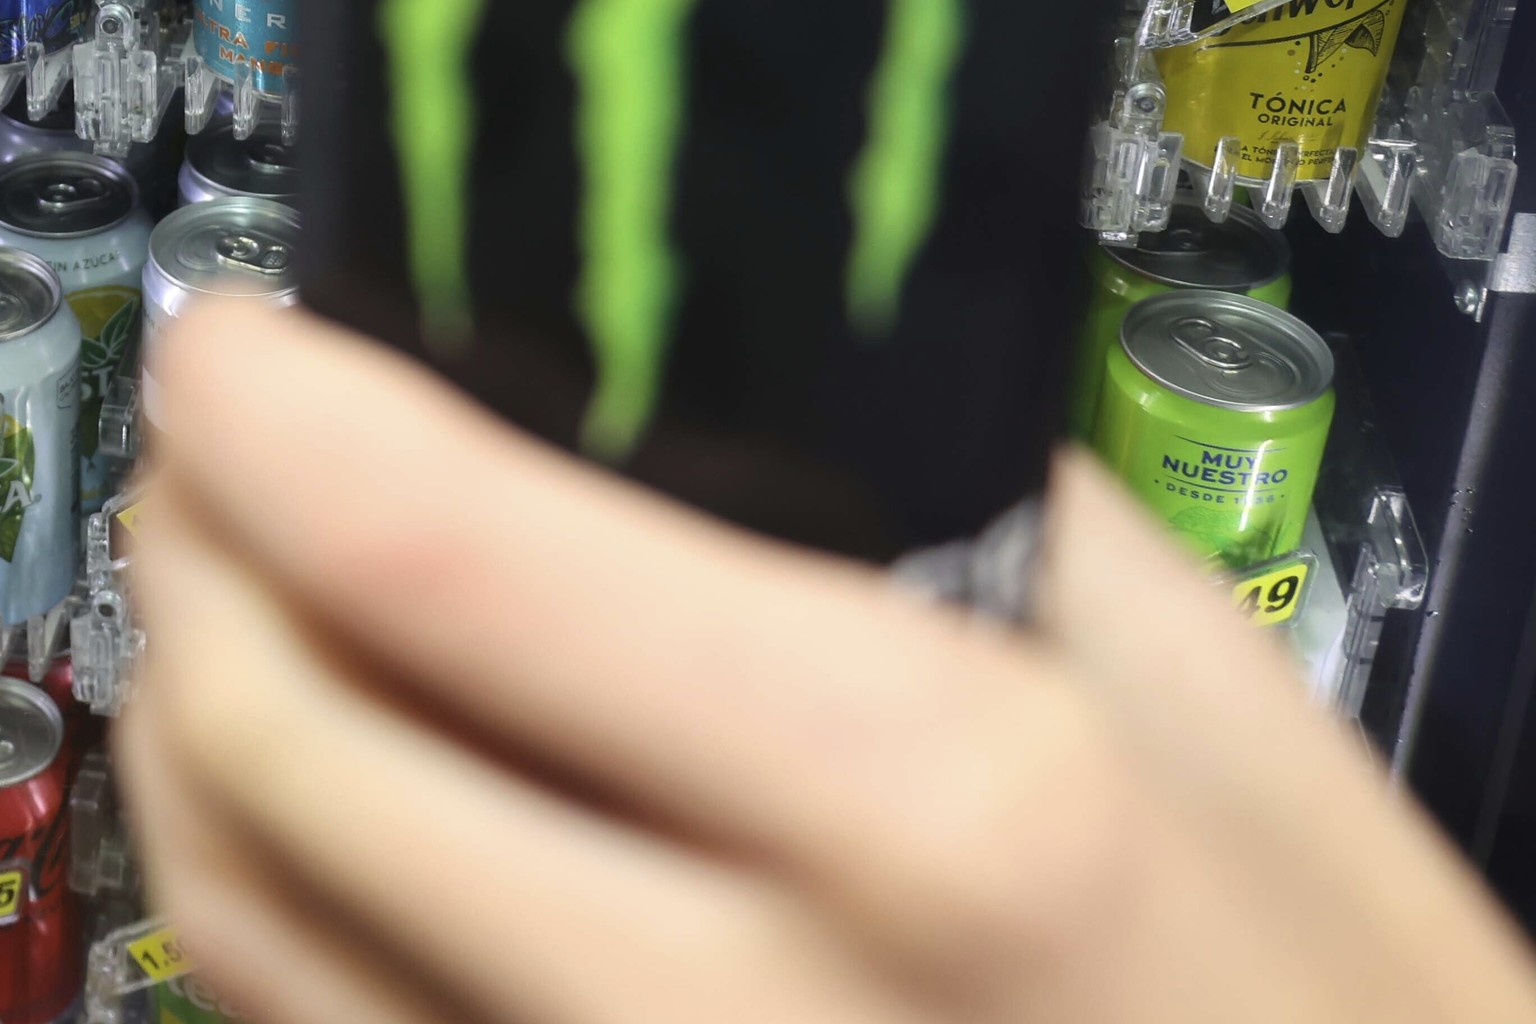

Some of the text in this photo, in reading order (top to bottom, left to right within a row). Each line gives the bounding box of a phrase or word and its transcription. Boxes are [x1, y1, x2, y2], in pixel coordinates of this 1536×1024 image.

[1249, 92, 1347, 116] TÓNICA
[1257, 112, 1334, 127] ORIGINAL
[1162, 455, 1290, 487] NUESTRO
[1202, 450, 1260, 470] MUY
[1166, 482, 1226, 504] DESDE
